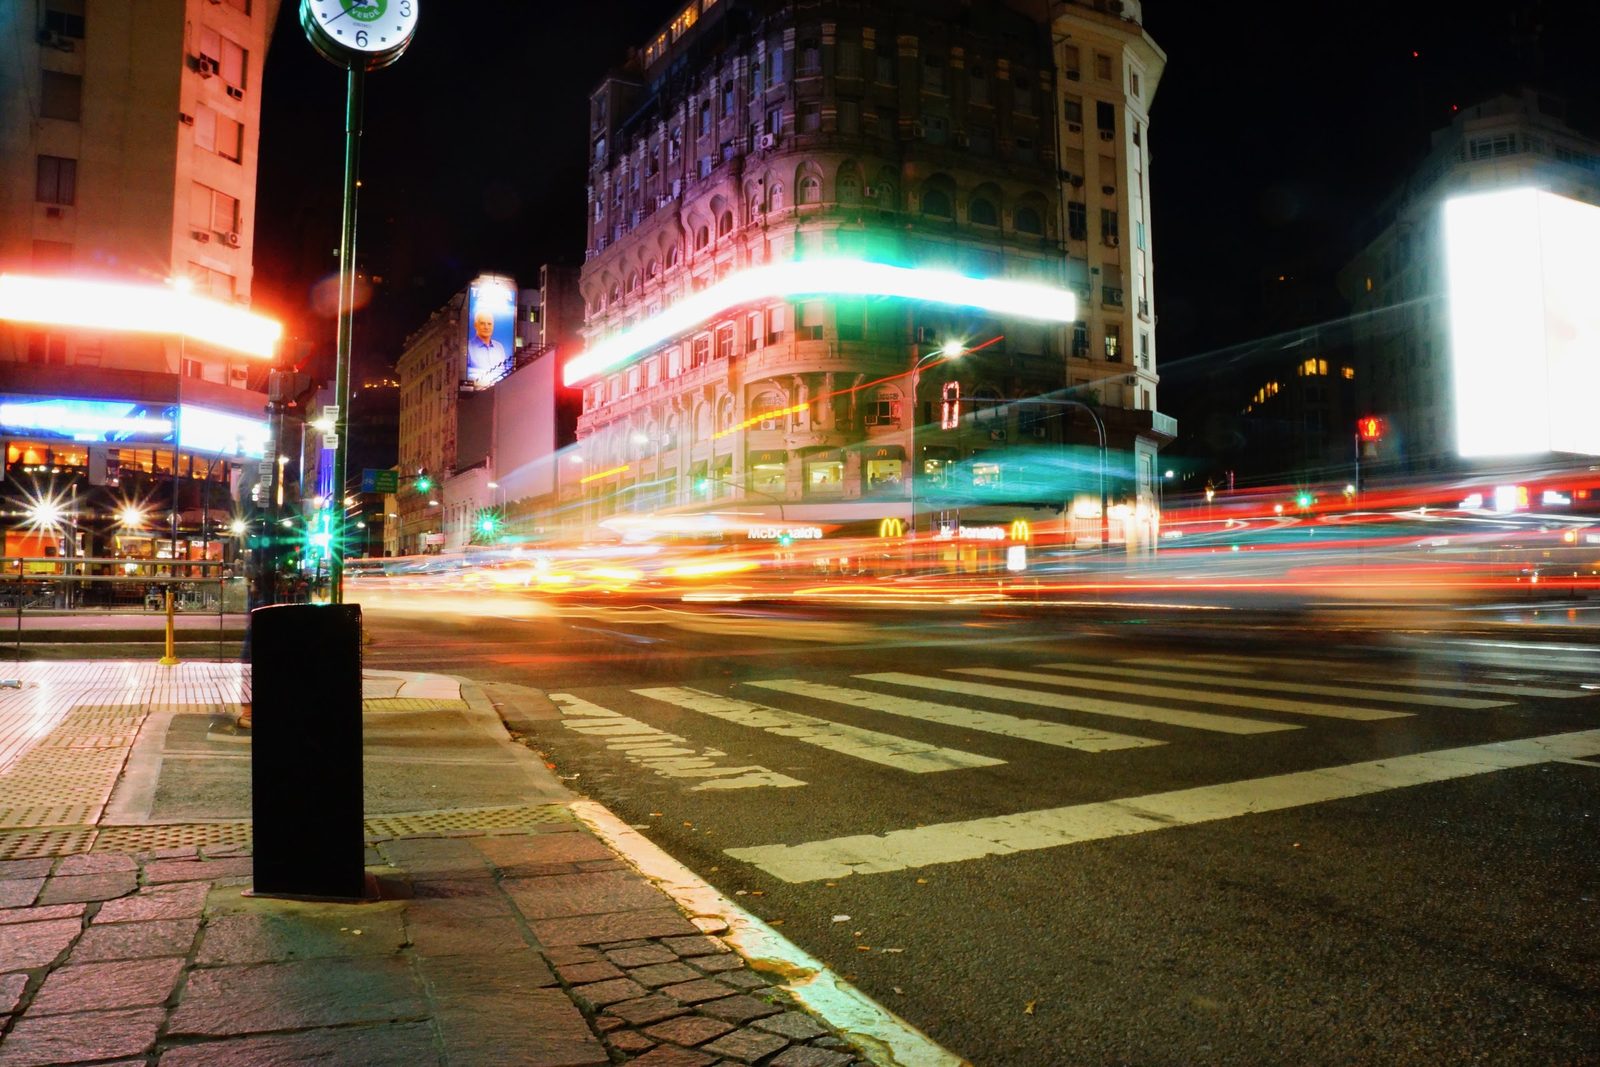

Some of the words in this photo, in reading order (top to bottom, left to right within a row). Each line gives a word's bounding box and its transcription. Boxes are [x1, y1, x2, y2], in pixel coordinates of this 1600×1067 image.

[352, 9, 380, 19] VERDE
[400, 0, 411, 17] 3
[356, 30, 368, 48] 6
[941, 525, 1006, 540] MDonald's
